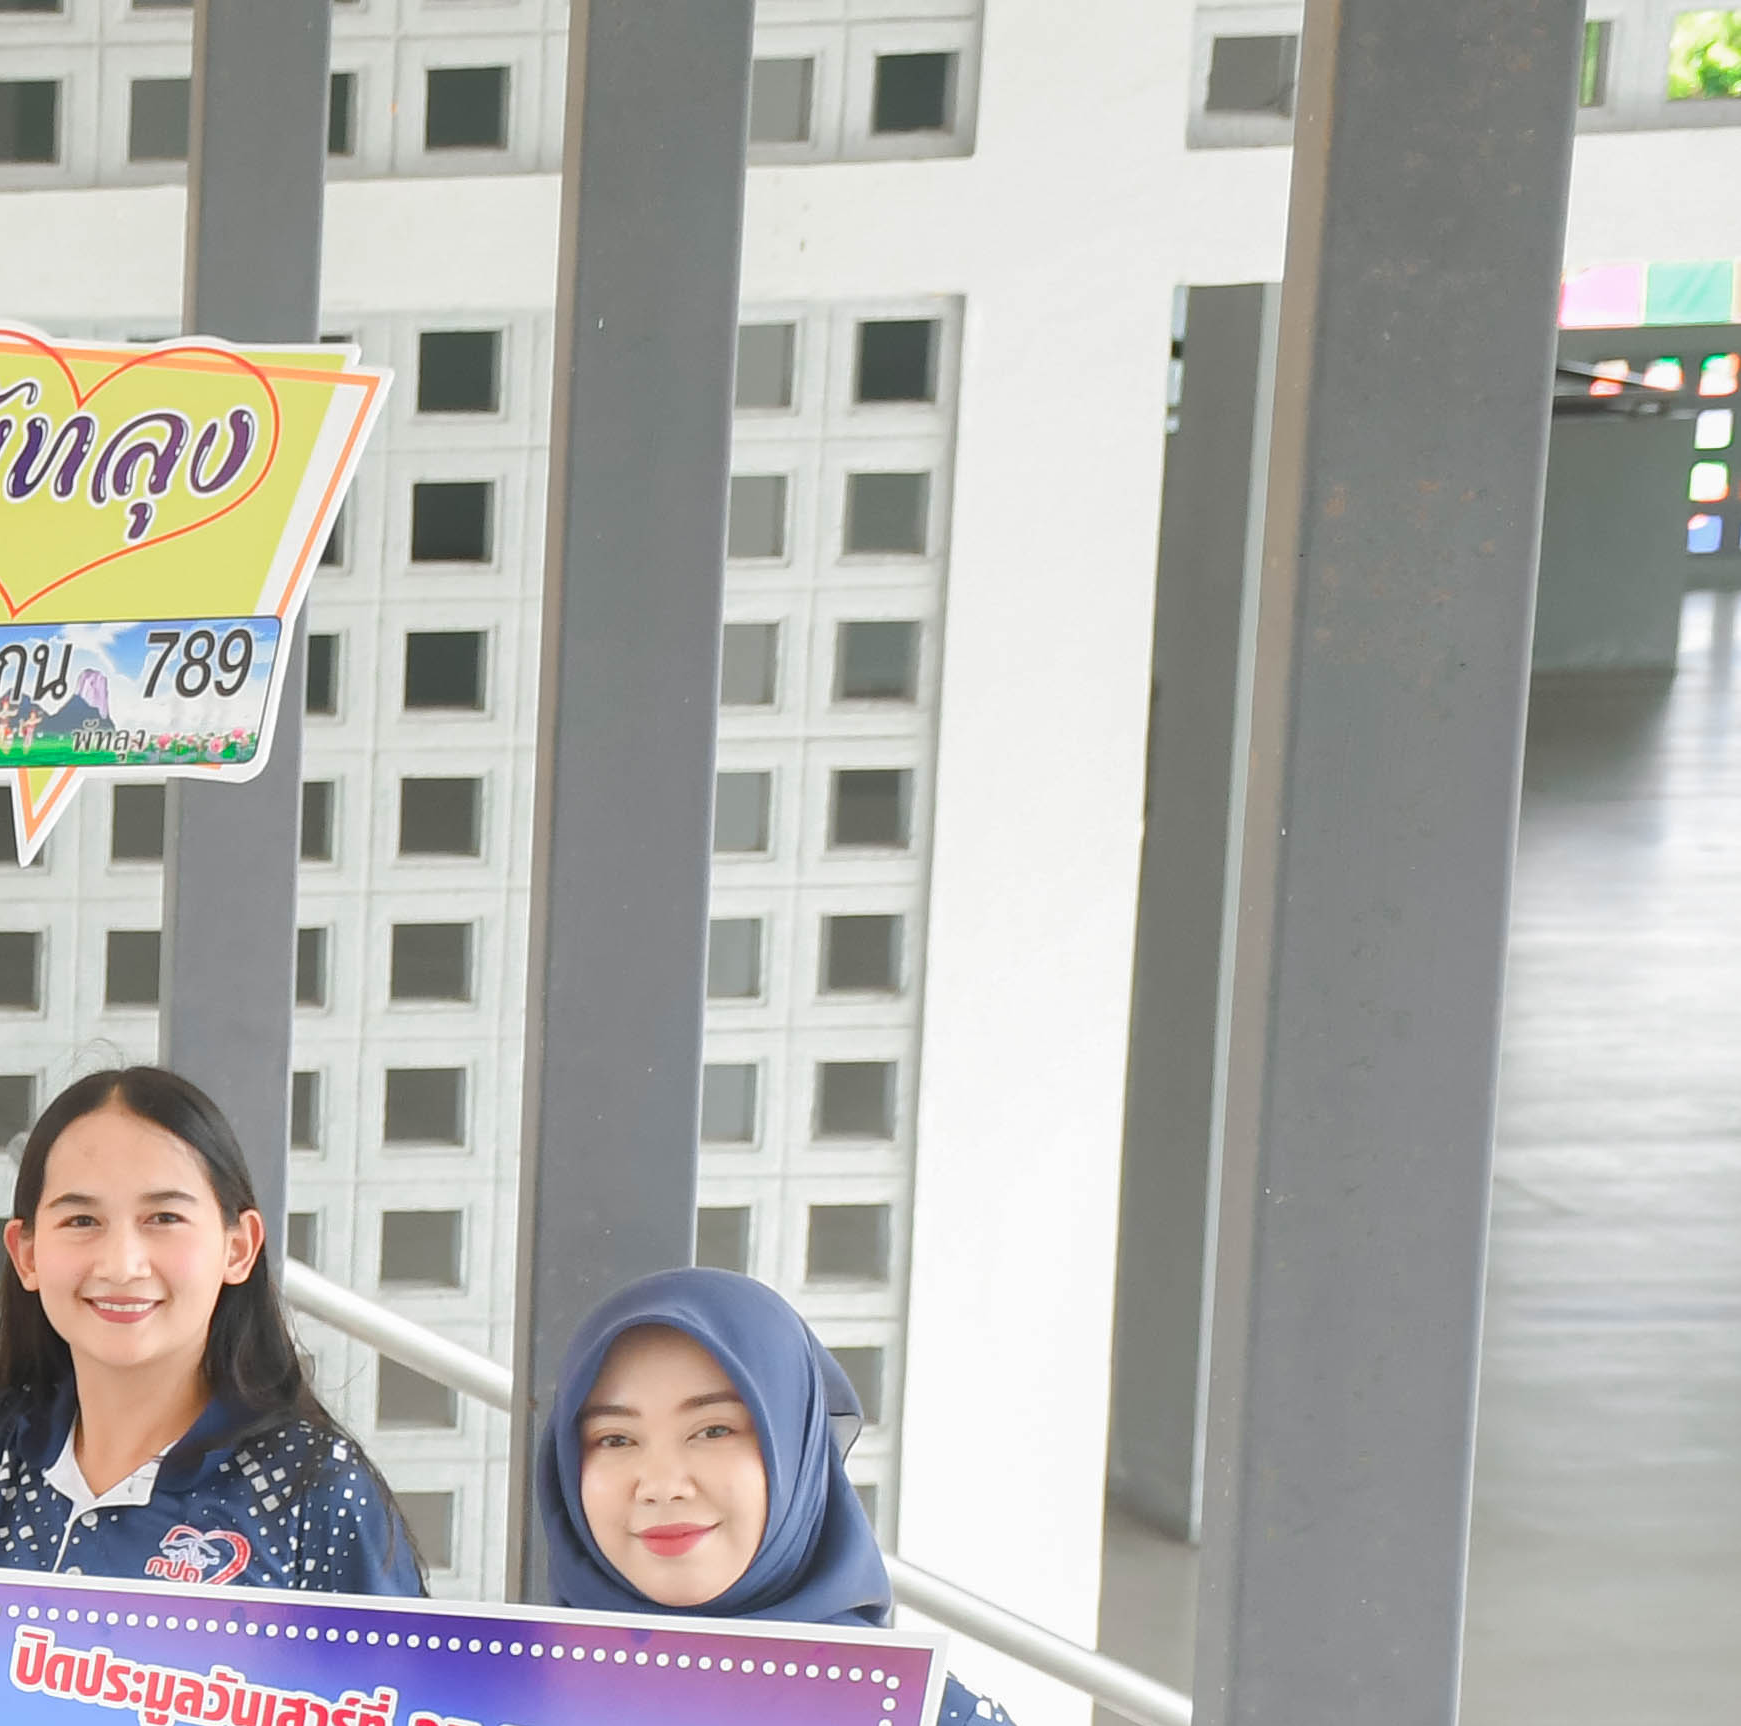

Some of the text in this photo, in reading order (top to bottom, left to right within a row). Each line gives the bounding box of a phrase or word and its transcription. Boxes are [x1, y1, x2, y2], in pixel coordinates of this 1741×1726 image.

[143, 629, 252, 698] 789
[72, 720, 148, 761] พัทลุง
